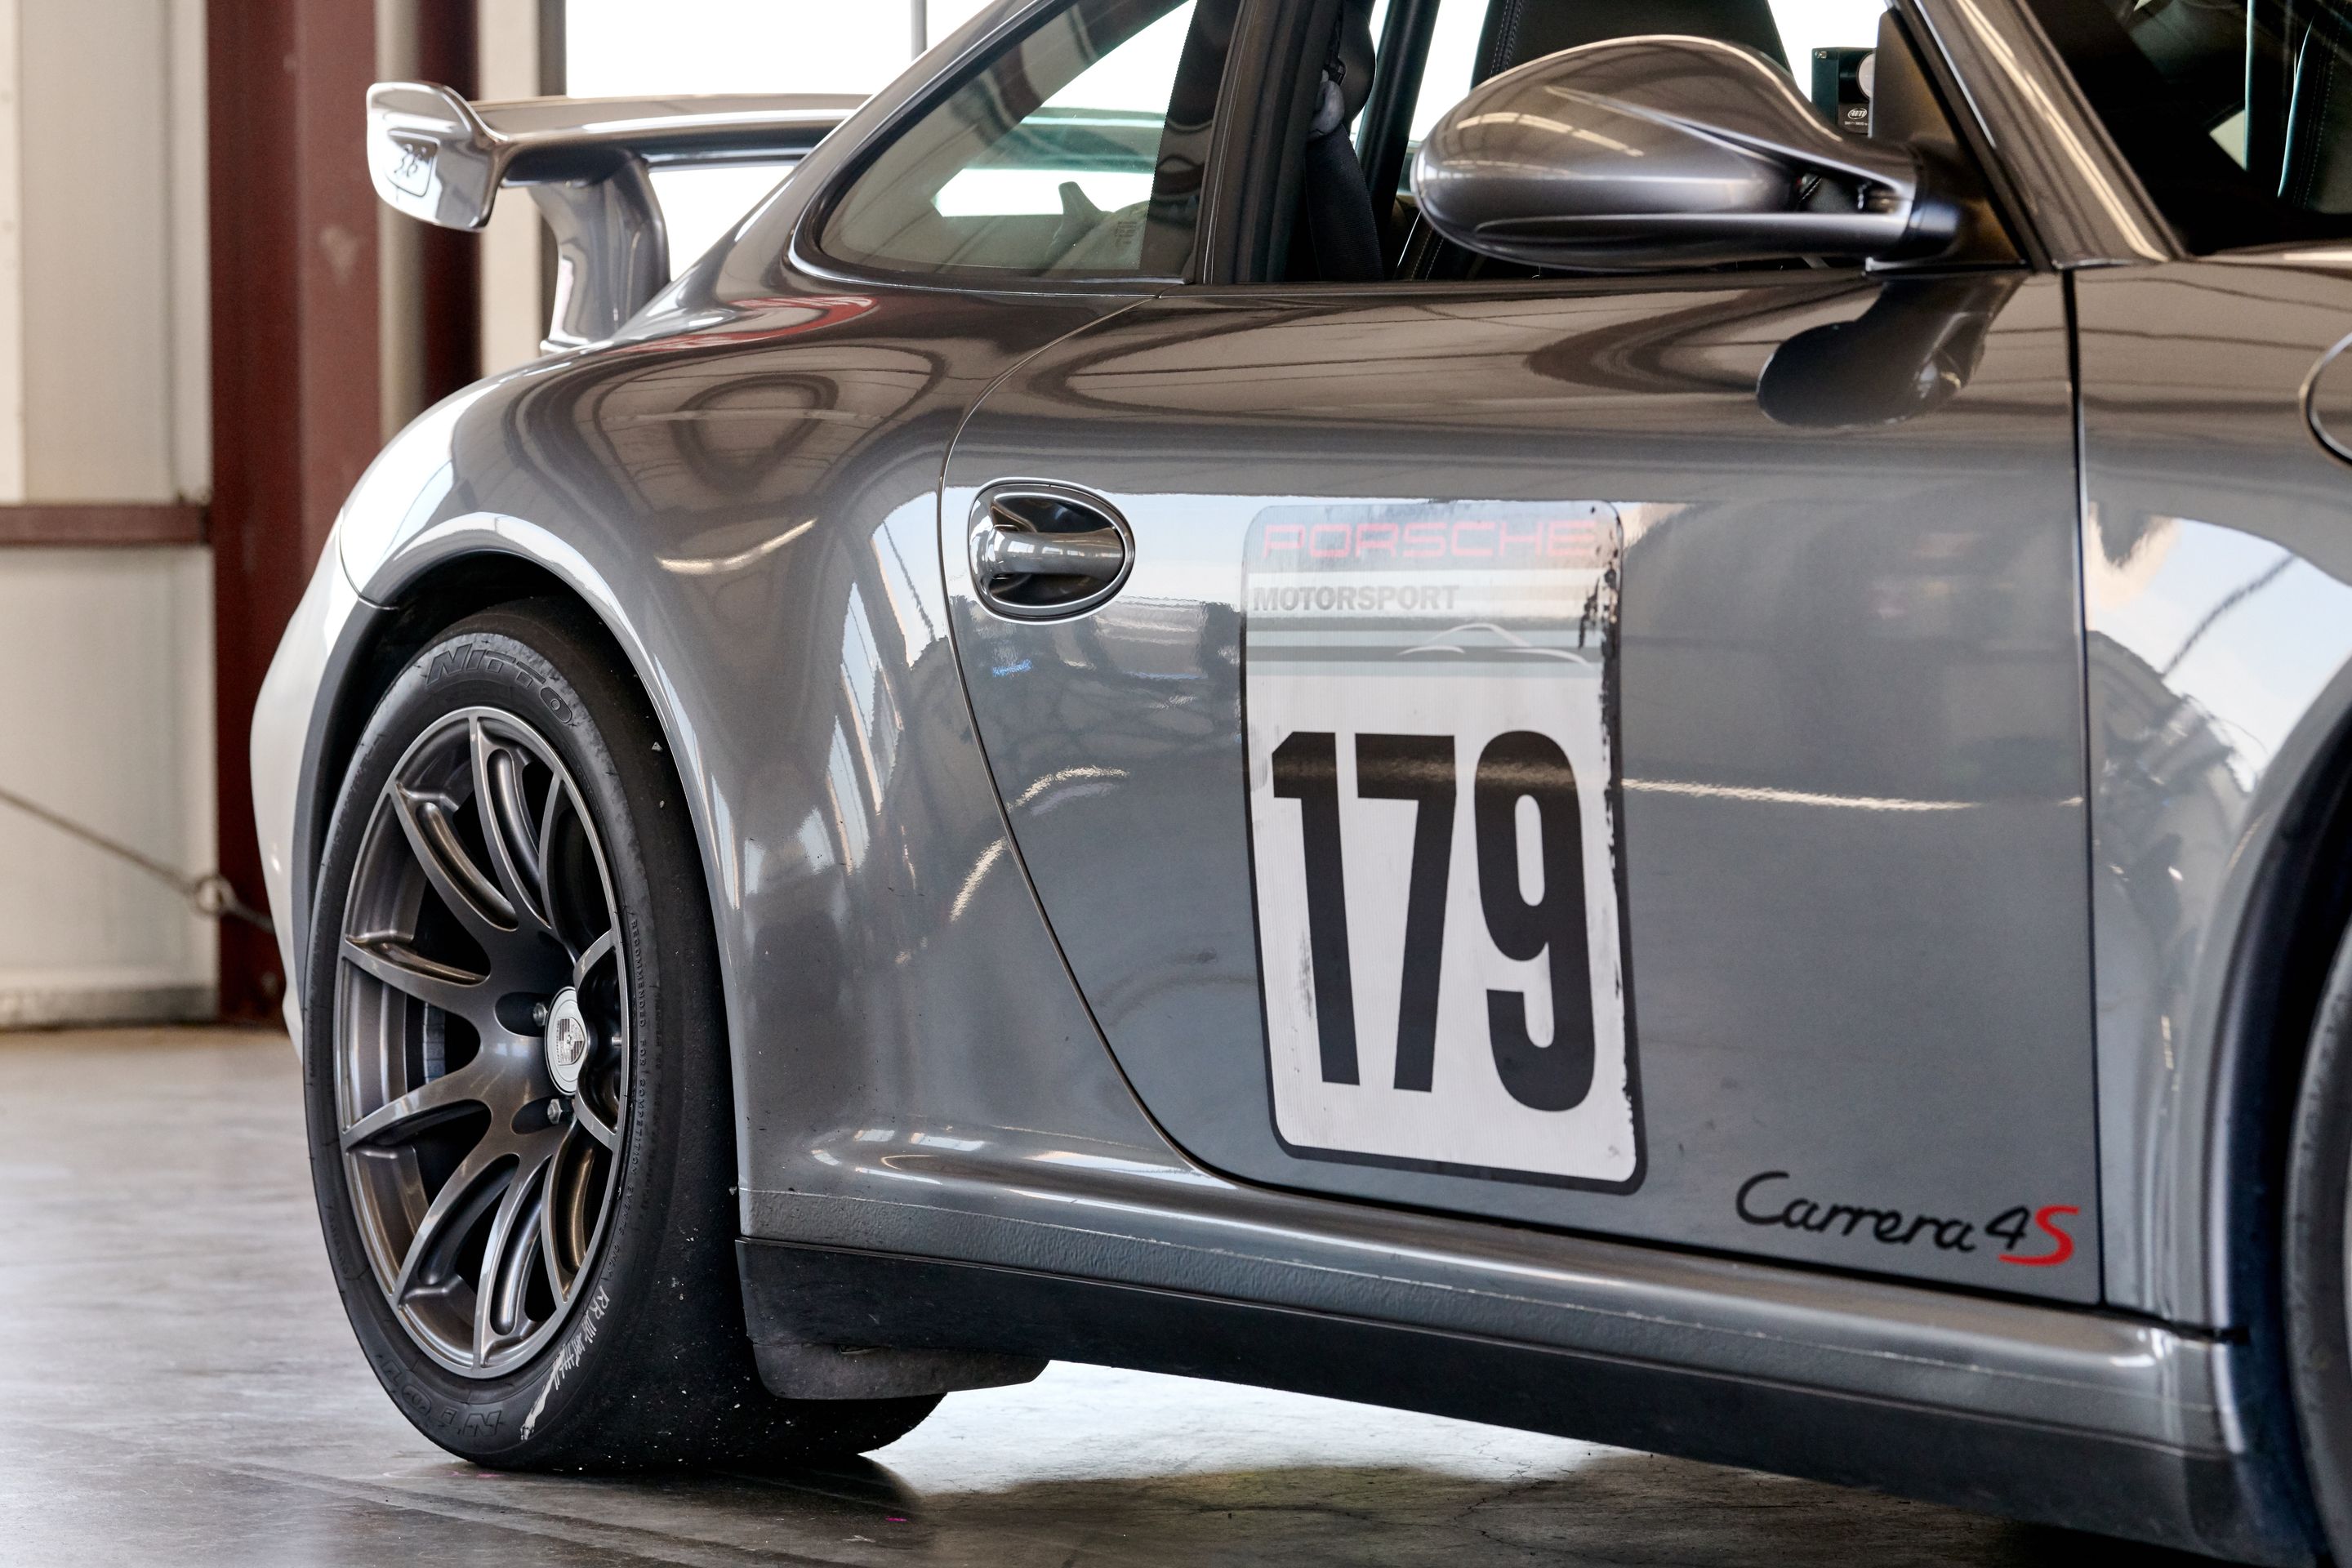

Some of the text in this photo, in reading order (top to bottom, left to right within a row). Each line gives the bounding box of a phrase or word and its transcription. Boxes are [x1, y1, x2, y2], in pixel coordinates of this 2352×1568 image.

[1262, 519, 1598, 559] PORSCHE
[1253, 584, 1460, 612] MOTORSPORT
[425, 643, 572, 724] NITTO
[1271, 729, 1596, 1112] 179
[630, 918, 647, 1027] RECOMMENDED
[631, 1078, 646, 1174] COMPETITION
[619, 1183, 635, 1236] EVENTS
[1735, 1170, 2079, 1267] Carrera 4S
